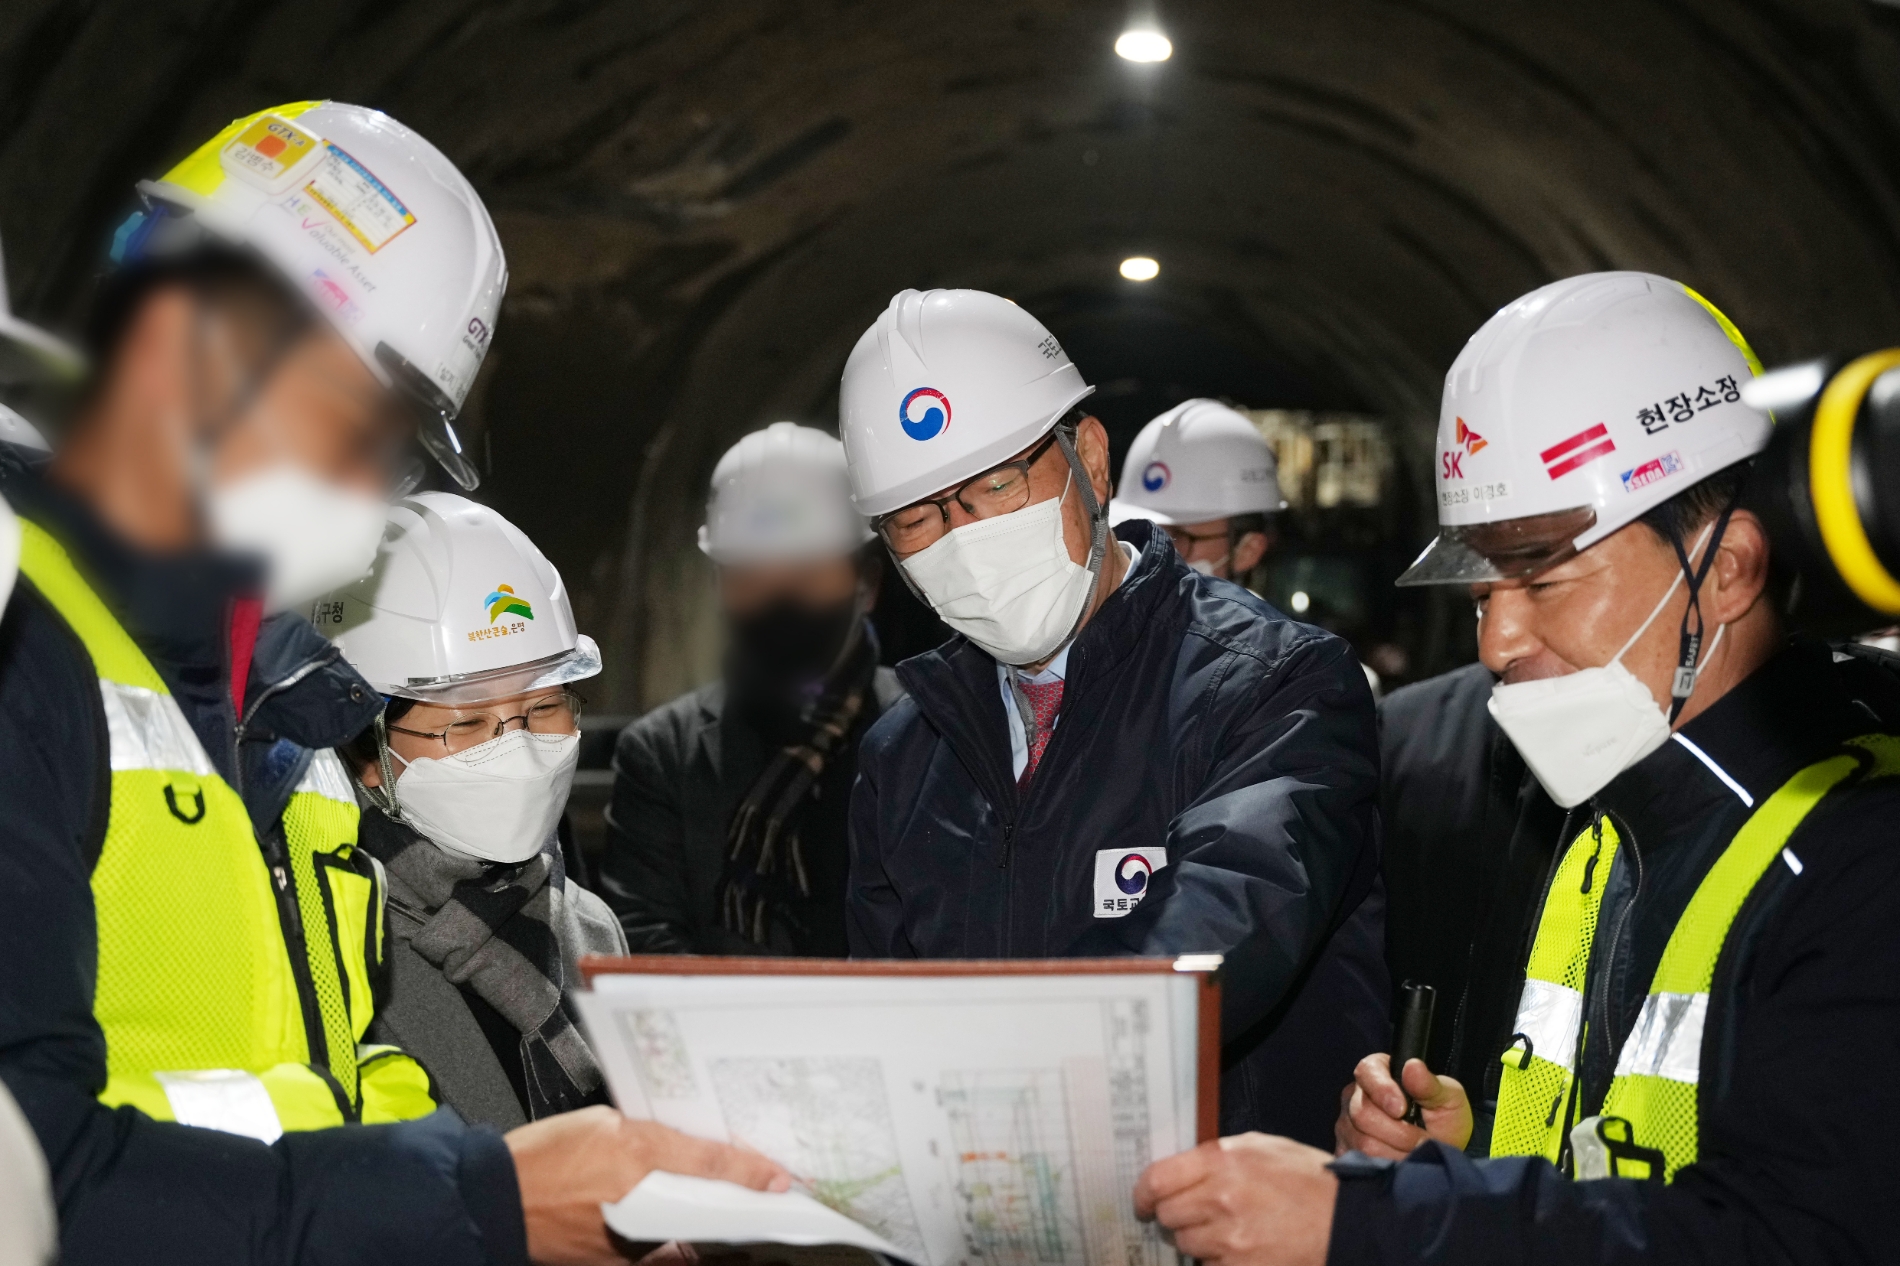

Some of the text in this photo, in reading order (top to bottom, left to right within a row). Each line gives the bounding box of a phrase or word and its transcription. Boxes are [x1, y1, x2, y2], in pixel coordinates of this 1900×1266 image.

[347, 265, 377, 293] Asset
[1037, 334, 1062, 360] 국토
[1636, 374, 1740, 436] 현장소장
[1443, 451, 1464, 480] SK
